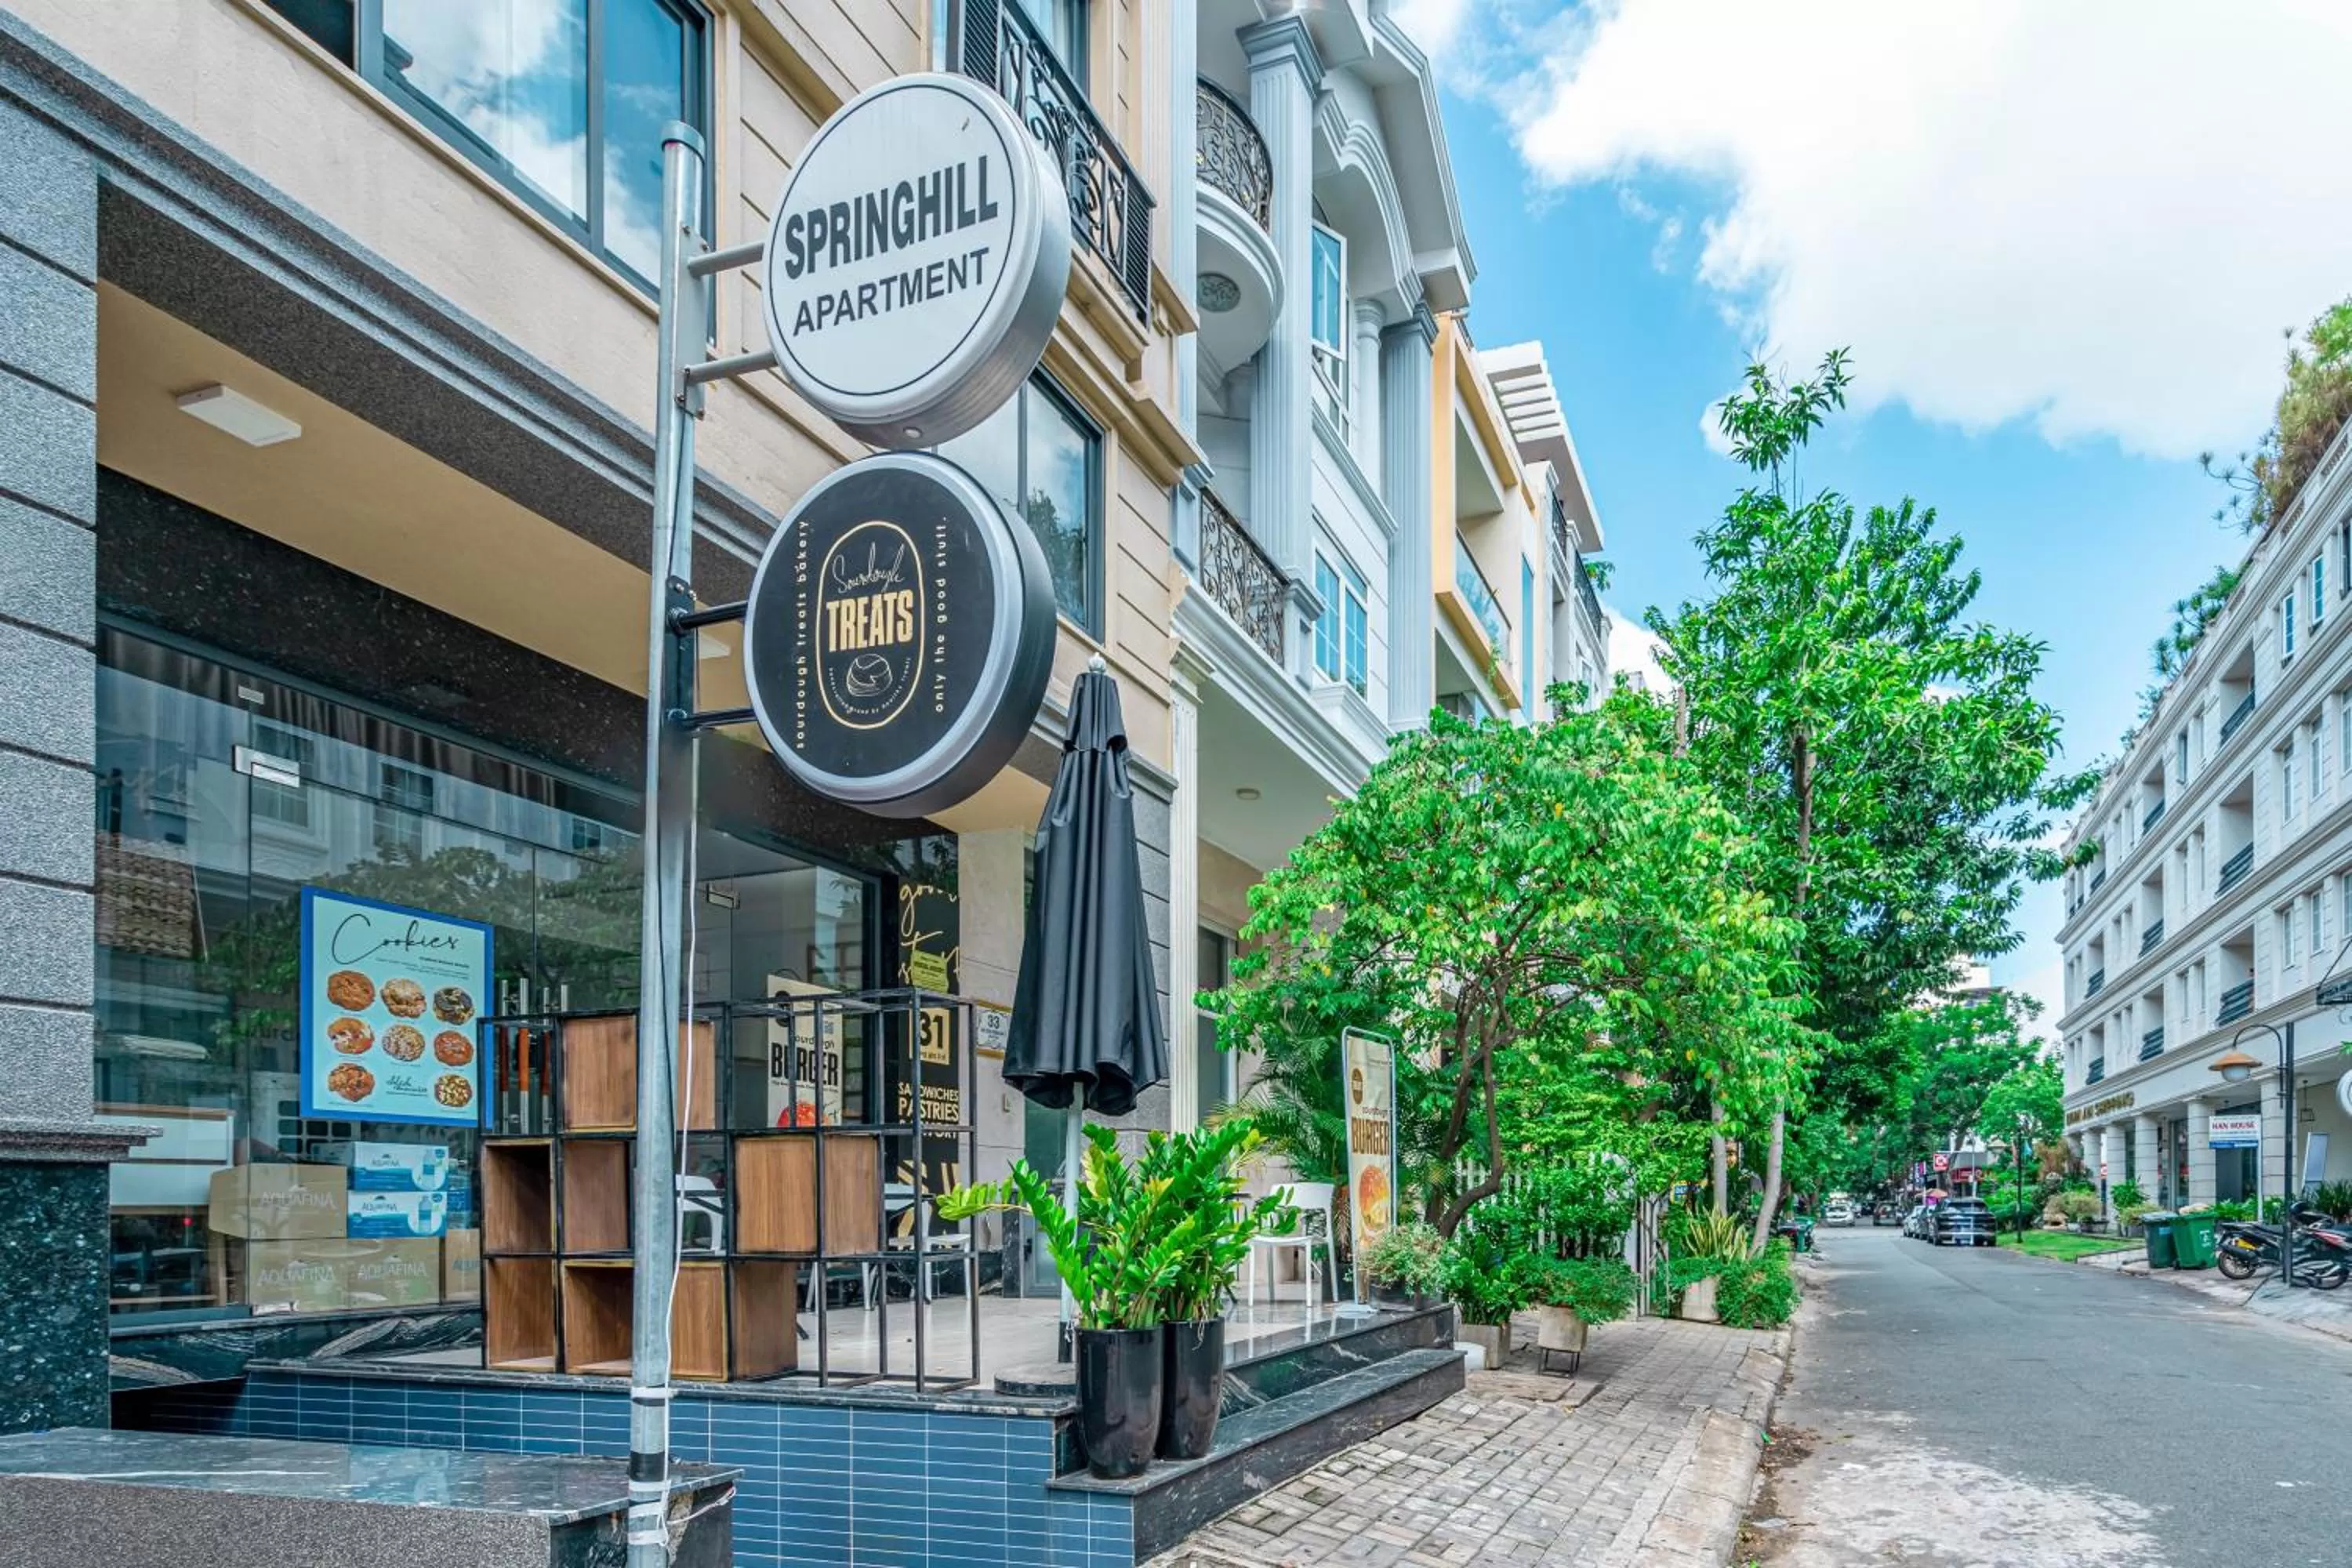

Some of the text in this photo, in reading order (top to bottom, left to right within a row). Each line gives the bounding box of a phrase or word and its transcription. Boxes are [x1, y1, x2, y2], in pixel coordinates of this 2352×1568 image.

[785, 155, 998, 280] SPRINGHILL
[793, 248, 990, 337] APARTMENT
[832, 541, 905, 594] Sourdough
[935, 578, 948, 623] good
[797, 521, 809, 749] sourdough treats bakery
[826, 589, 914, 653] TREATS
[935, 634, 945, 662] the
[934, 674, 946, 713] only
[332, 913, 461, 965] Cookies
[918, 1011, 943, 1049] 31
[987, 1014, 1000, 1029] 33
[898, 1081, 959, 1102] SADWICHES
[1352, 1116, 1389, 1156] BURGER
[260, 1191, 338, 1210] AQUAFINA
[358, 1261, 428, 1279] AQUAFINA
